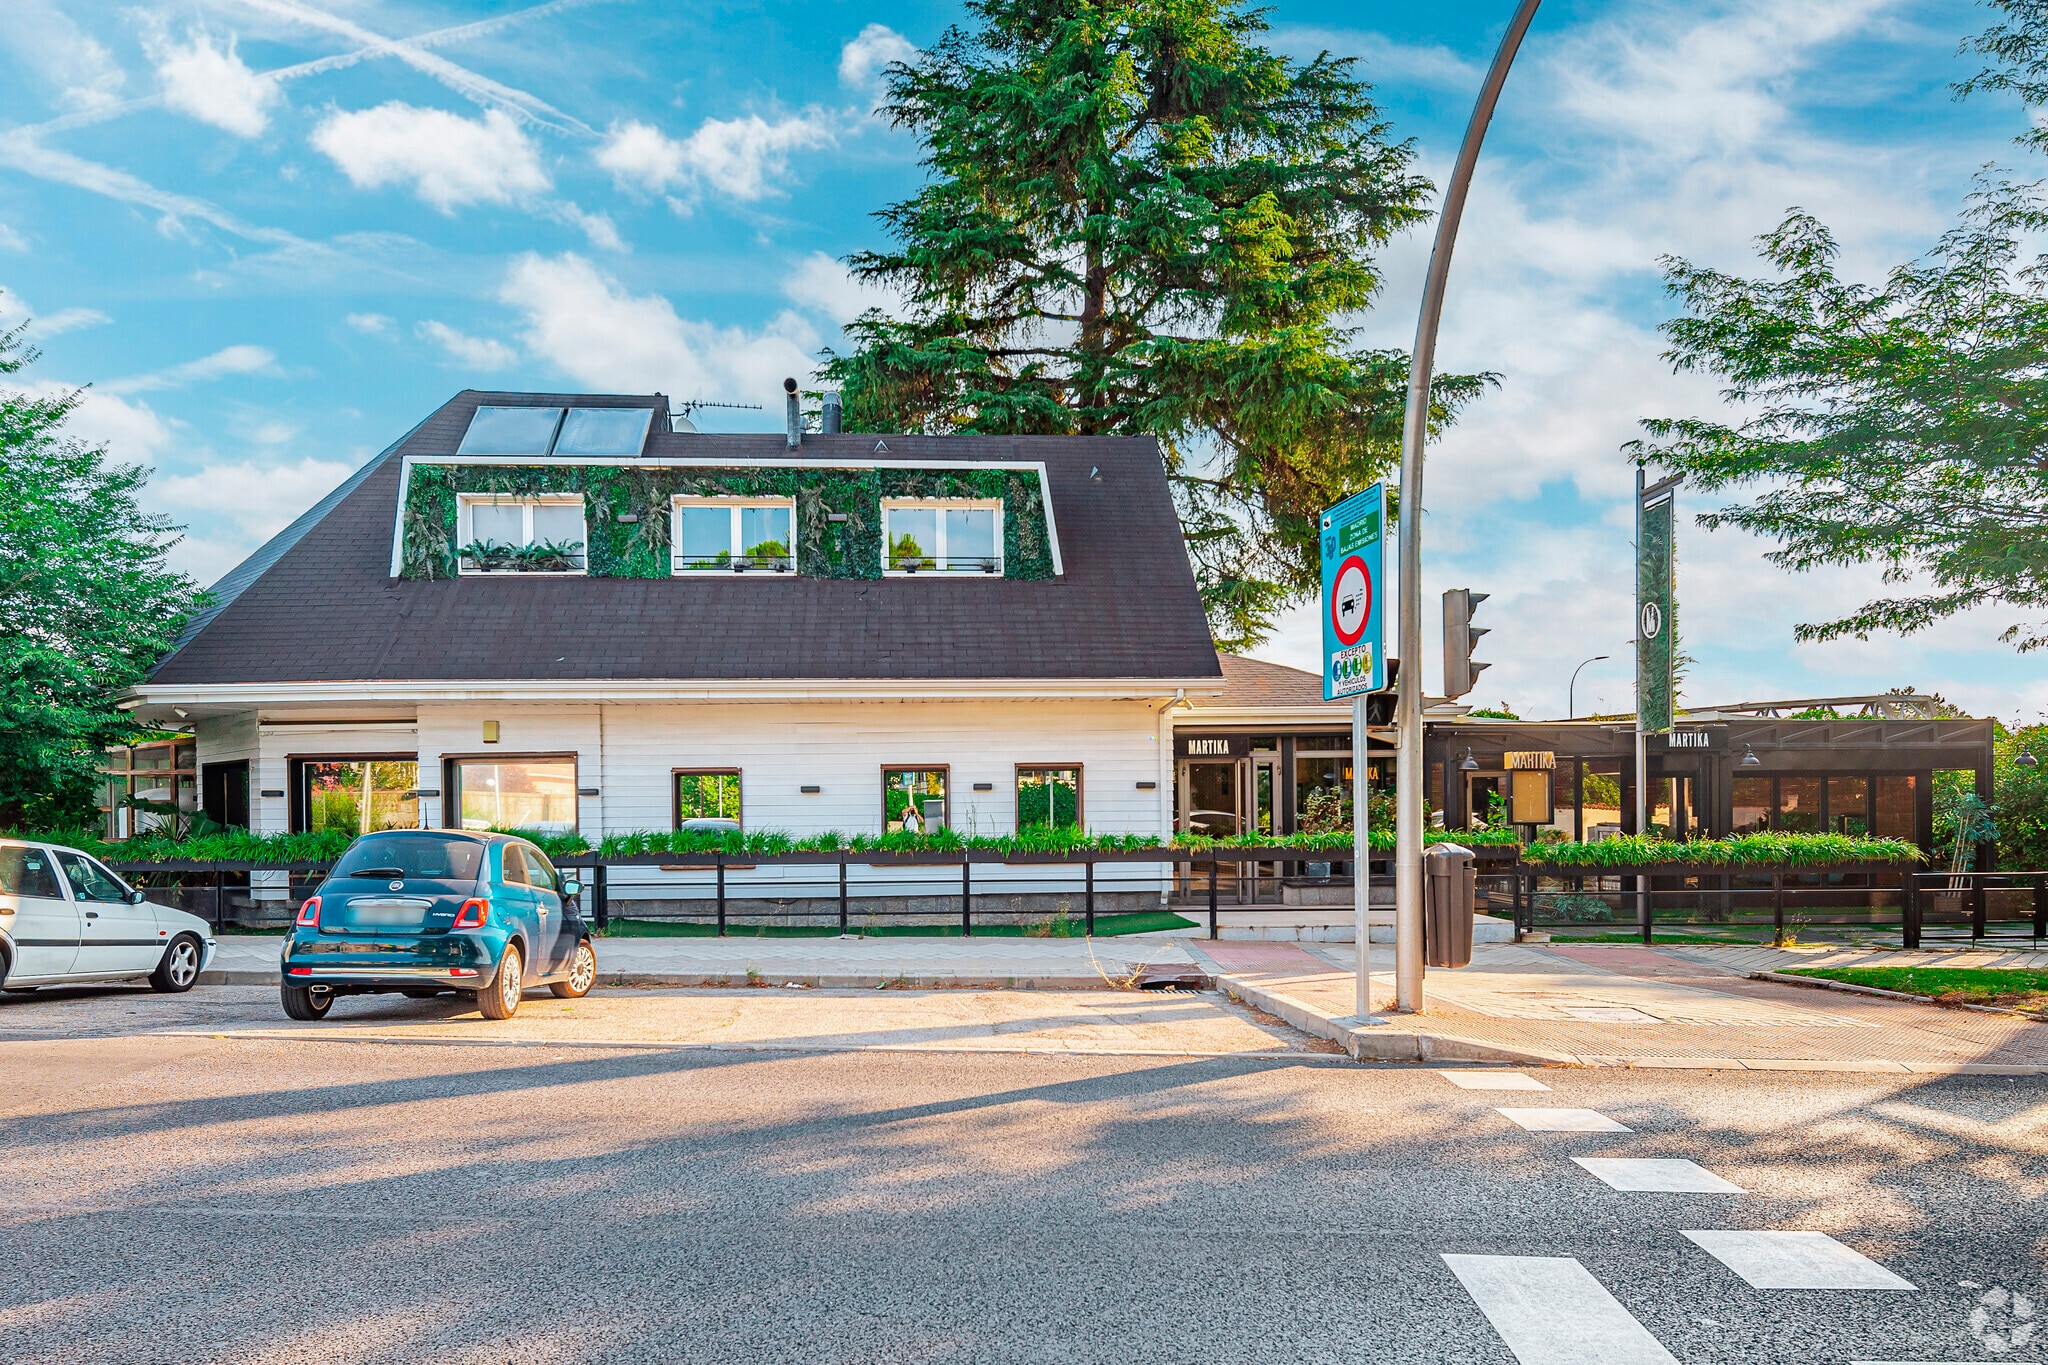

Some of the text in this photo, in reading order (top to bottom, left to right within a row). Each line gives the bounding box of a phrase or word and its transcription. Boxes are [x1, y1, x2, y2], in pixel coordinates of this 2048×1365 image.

[1351, 518, 1367, 530] MADRID
[1349, 526, 1368, 541] ZONA DE
[1341, 542, 1354, 554] BAJAS
[1355, 531, 1378, 547] EMISIONES
[1341, 645, 1366, 659] EXCEPTO
[1337, 683, 1368, 695] AUTORIZADOS
[1188, 739, 1229, 755] MARTIKA
[1669, 733, 1709, 748] MARTIKA
[1511, 752, 1556, 769] MARTIKA
